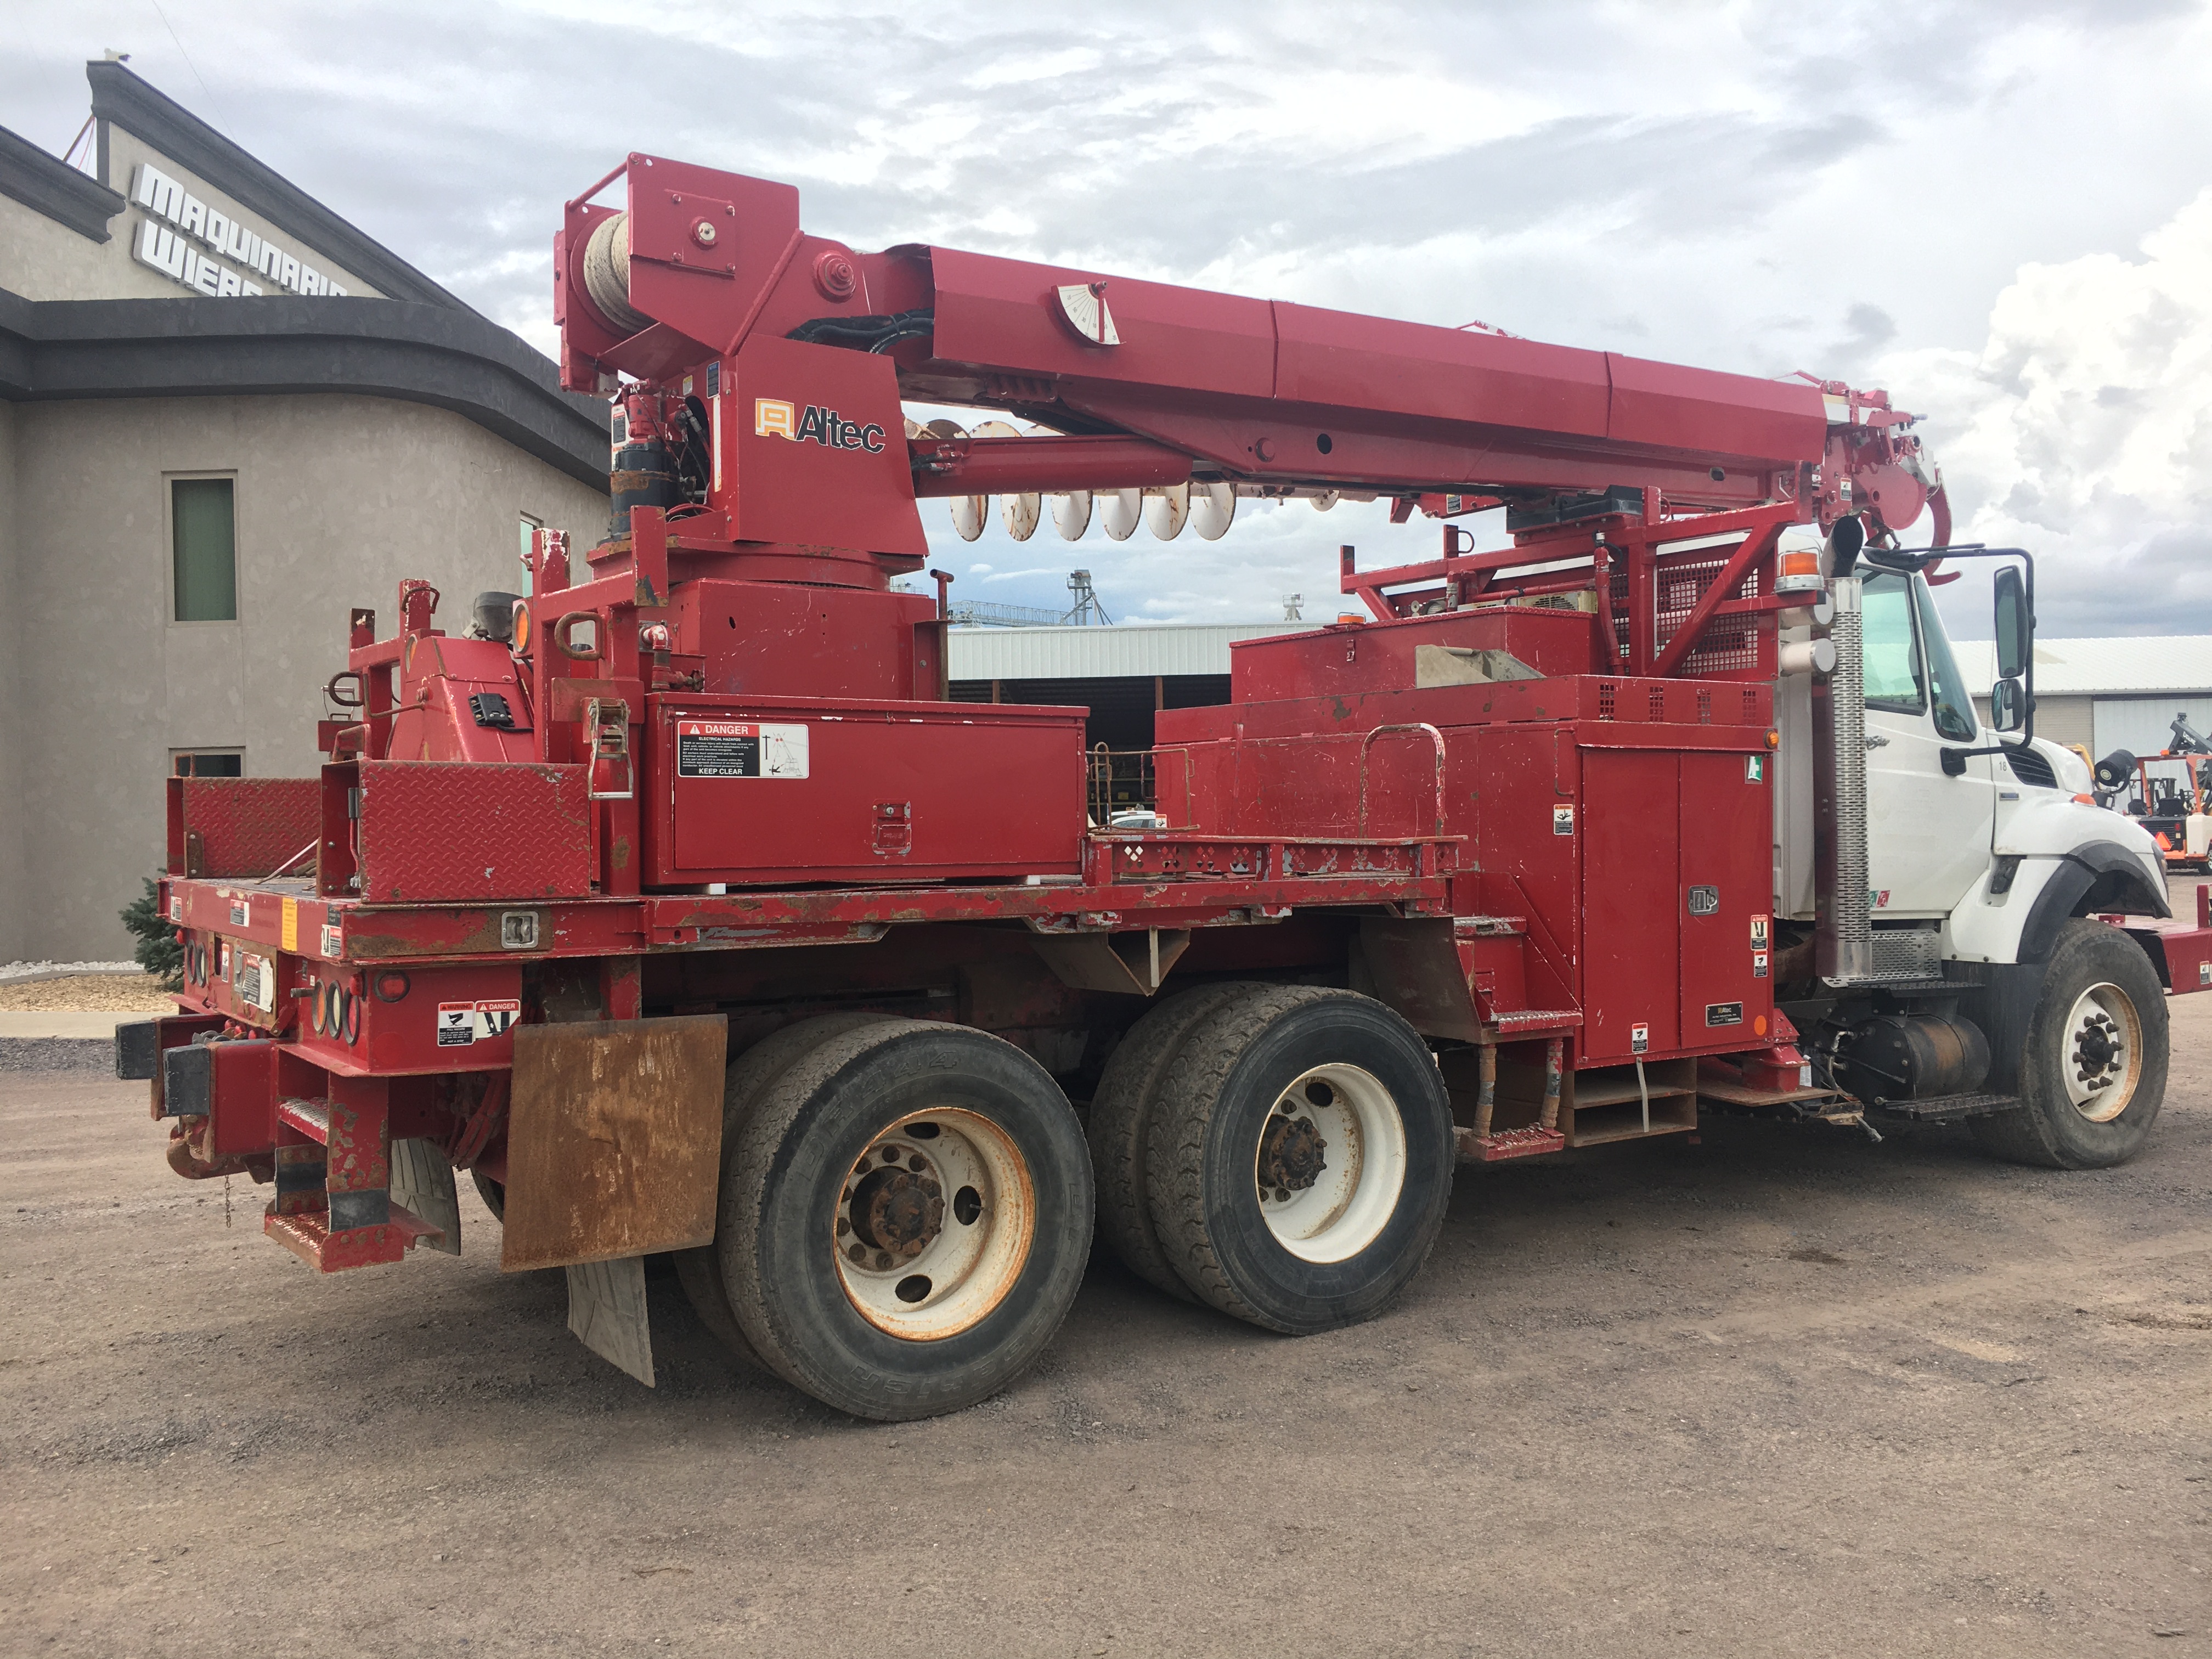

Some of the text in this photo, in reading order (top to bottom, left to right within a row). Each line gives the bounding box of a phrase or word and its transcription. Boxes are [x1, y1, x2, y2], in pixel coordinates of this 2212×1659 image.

[795, 404, 885, 454] Altec
[706, 725, 748, 735] DANGER
[1999, 761, 2007, 771] 18
